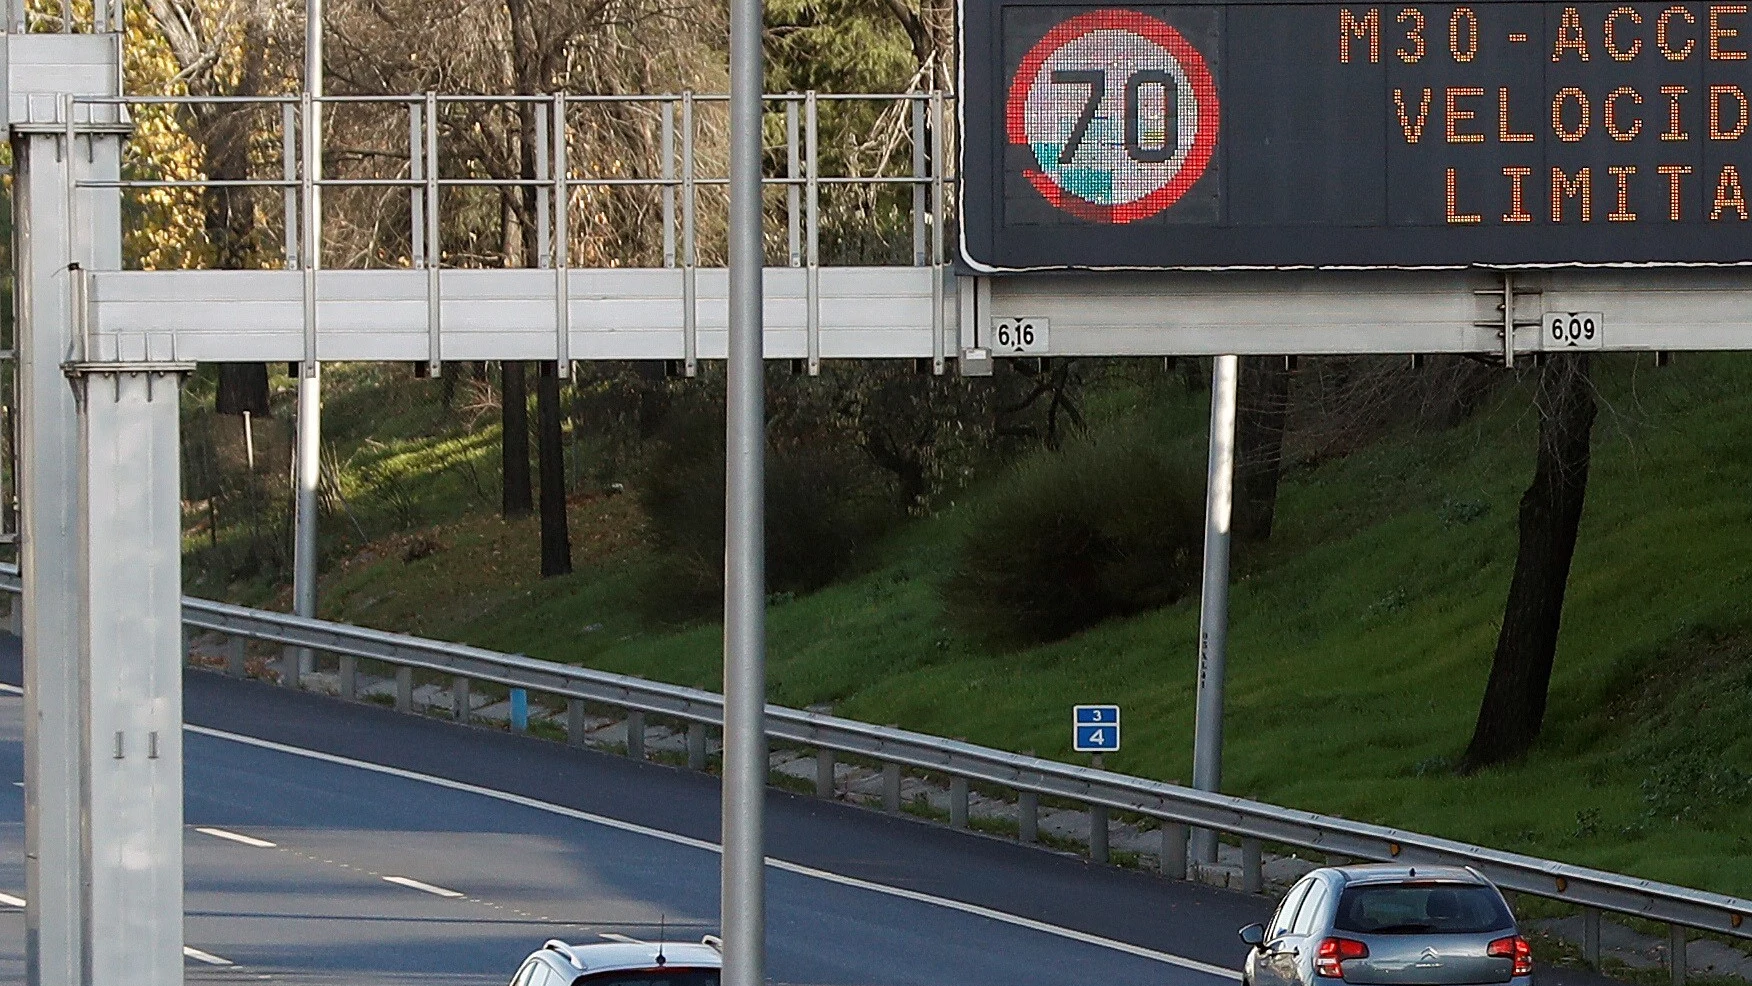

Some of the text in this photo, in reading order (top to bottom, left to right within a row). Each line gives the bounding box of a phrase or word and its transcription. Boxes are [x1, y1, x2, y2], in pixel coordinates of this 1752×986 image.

[1050, 69, 1179, 164] 70
[998, 324, 1035, 347] 6,16
[1551, 318, 1595, 341] 6,09
[1092, 709, 1103, 722] 3
[1088, 728, 1105, 746] 4
